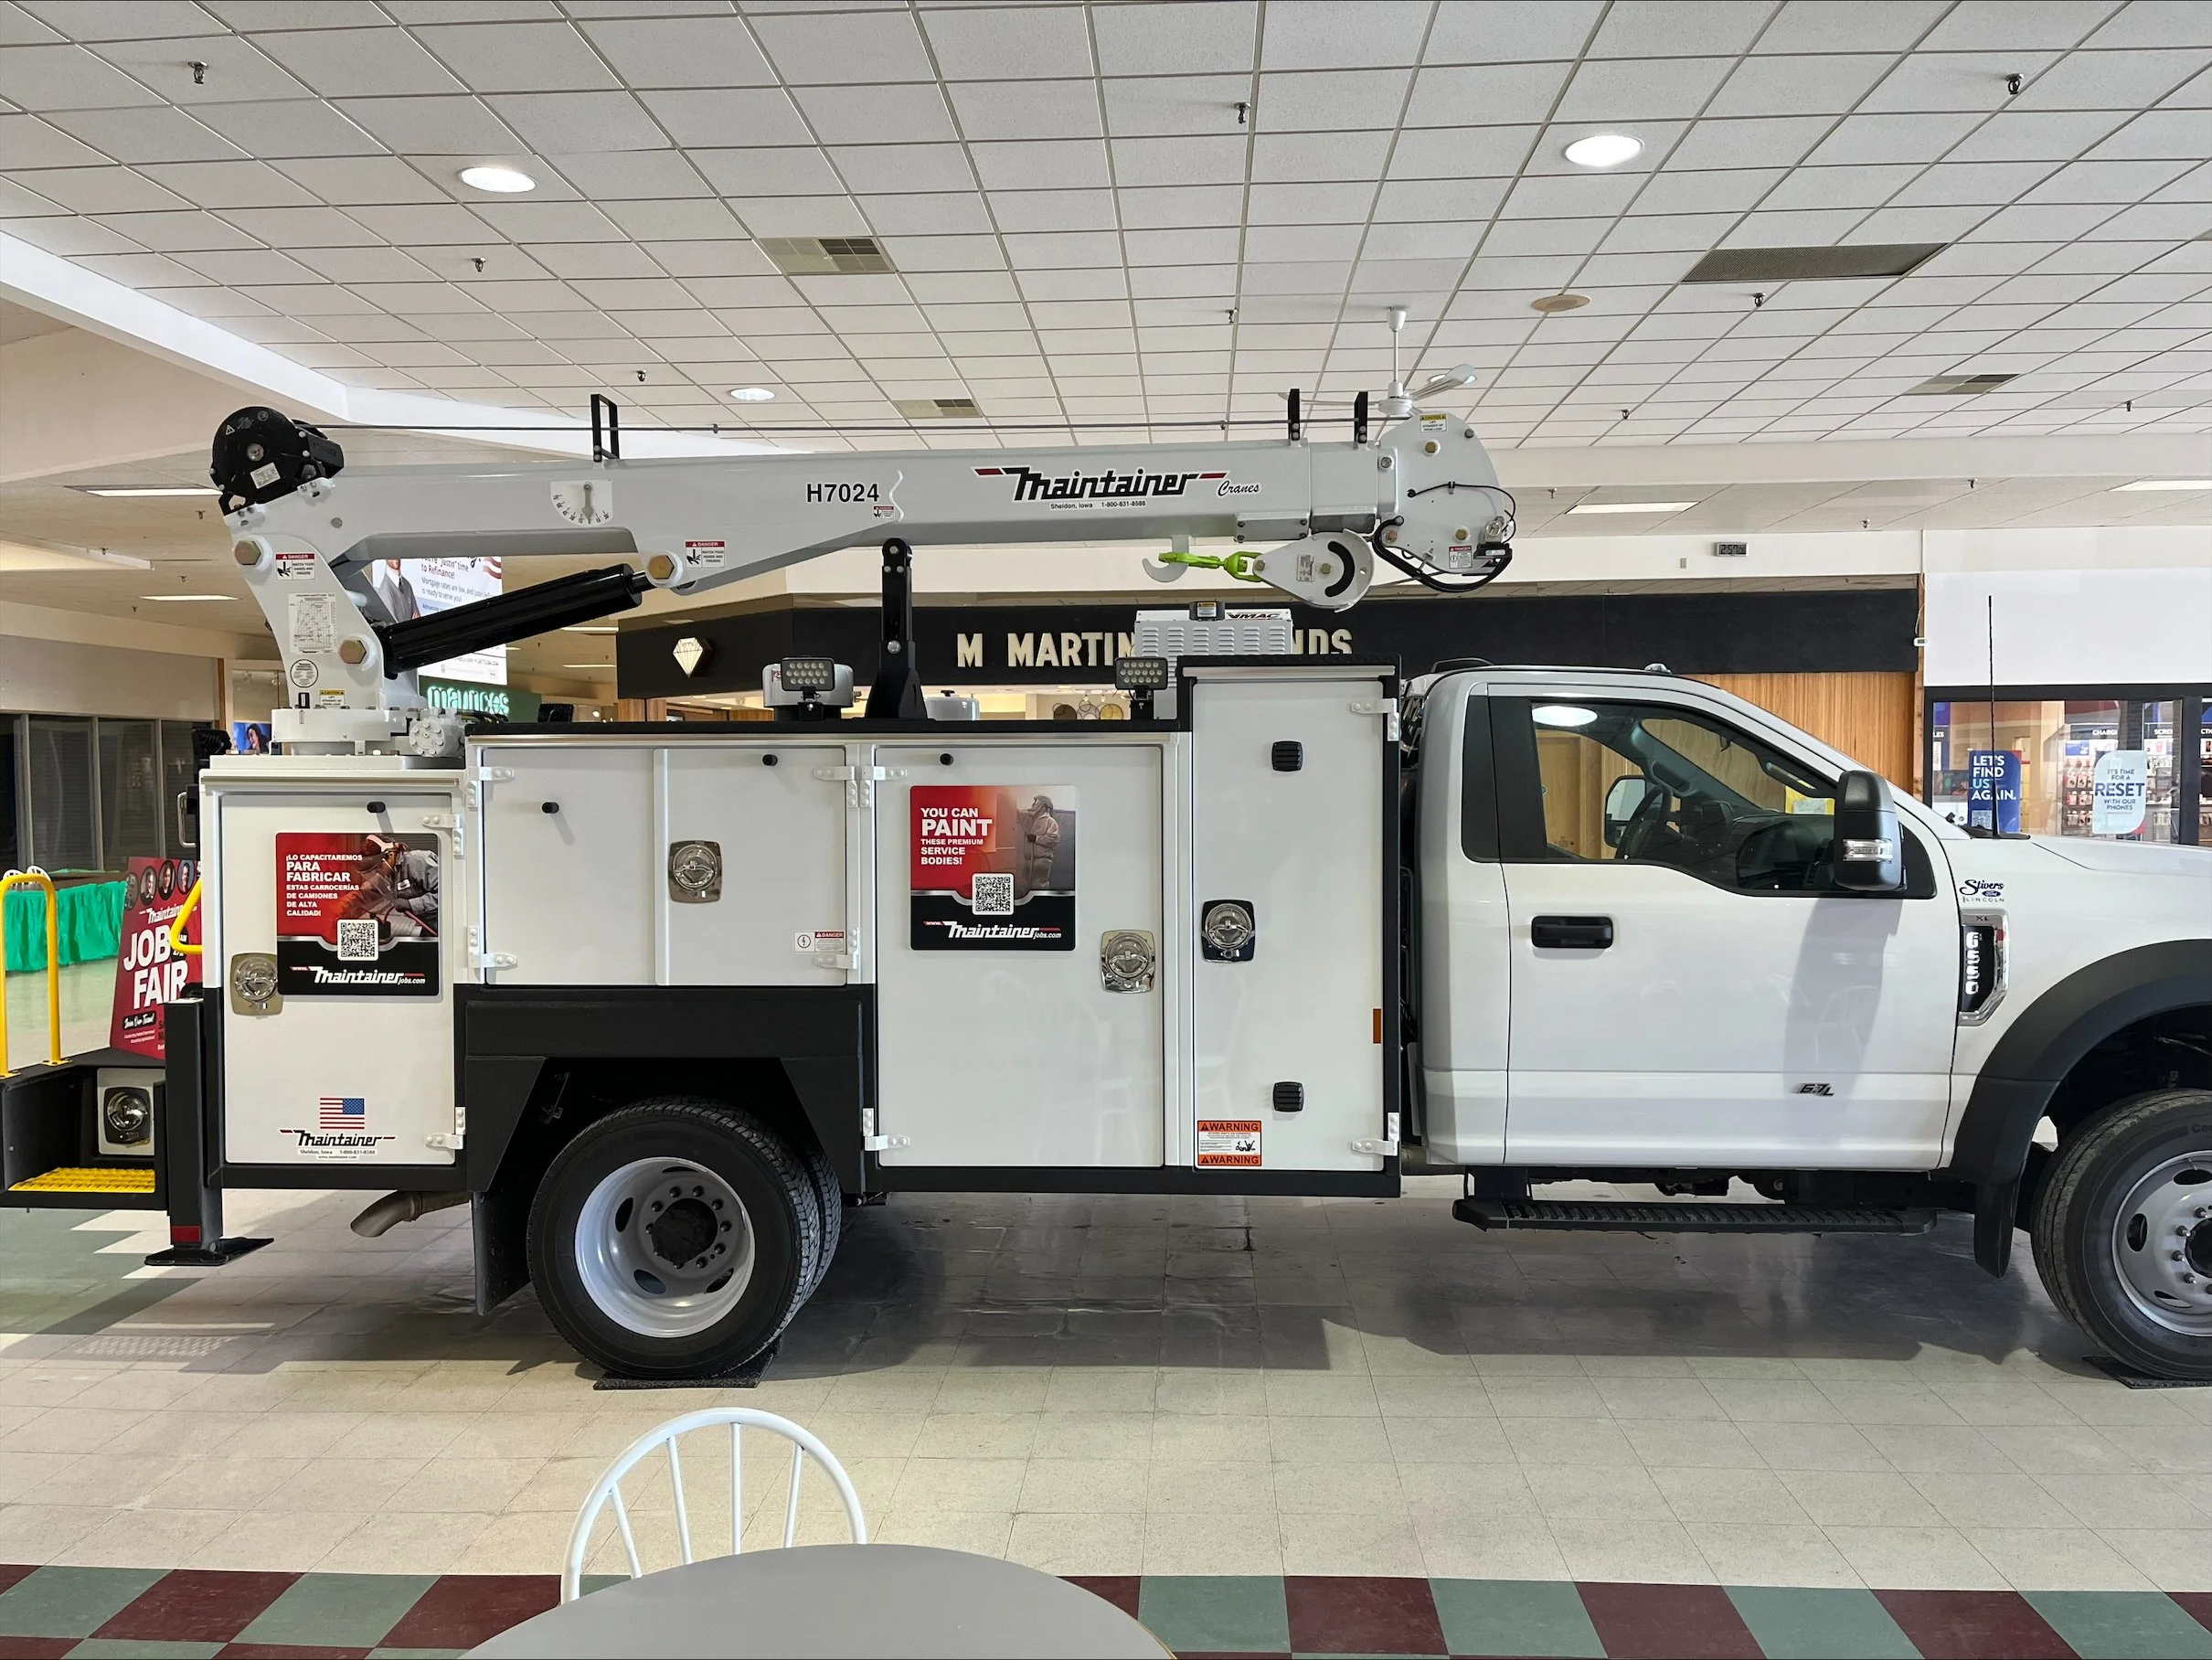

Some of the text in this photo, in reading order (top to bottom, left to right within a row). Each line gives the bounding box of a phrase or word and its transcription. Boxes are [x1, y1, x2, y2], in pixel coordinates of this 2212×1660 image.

[1002, 466, 1198, 501] Maintainer
[1217, 481, 1261, 496] Cranes
[806, 483, 879, 502] H7024
[957, 633, 983, 666] M
[427, 686, 509, 716] maurices
[1973, 767, 2005, 778] FIND
[1973, 778, 1990, 789] US
[2095, 782, 2145, 796] RESET
[920, 807, 979, 817] YOU CAN
[921, 819, 993, 836] PAINT
[286, 862, 320, 871] PARA
[286, 872, 351, 882] FABRICAR
[1959, 878, 2005, 895] Stivers
[122, 924, 171, 971] JOB
[133, 960, 188, 1010] FAIR
[1209, 1123, 1259, 1131] WARNING
[293, 1130, 382, 1146] Maintainer
[1209, 1155, 1259, 1164] WARNING
